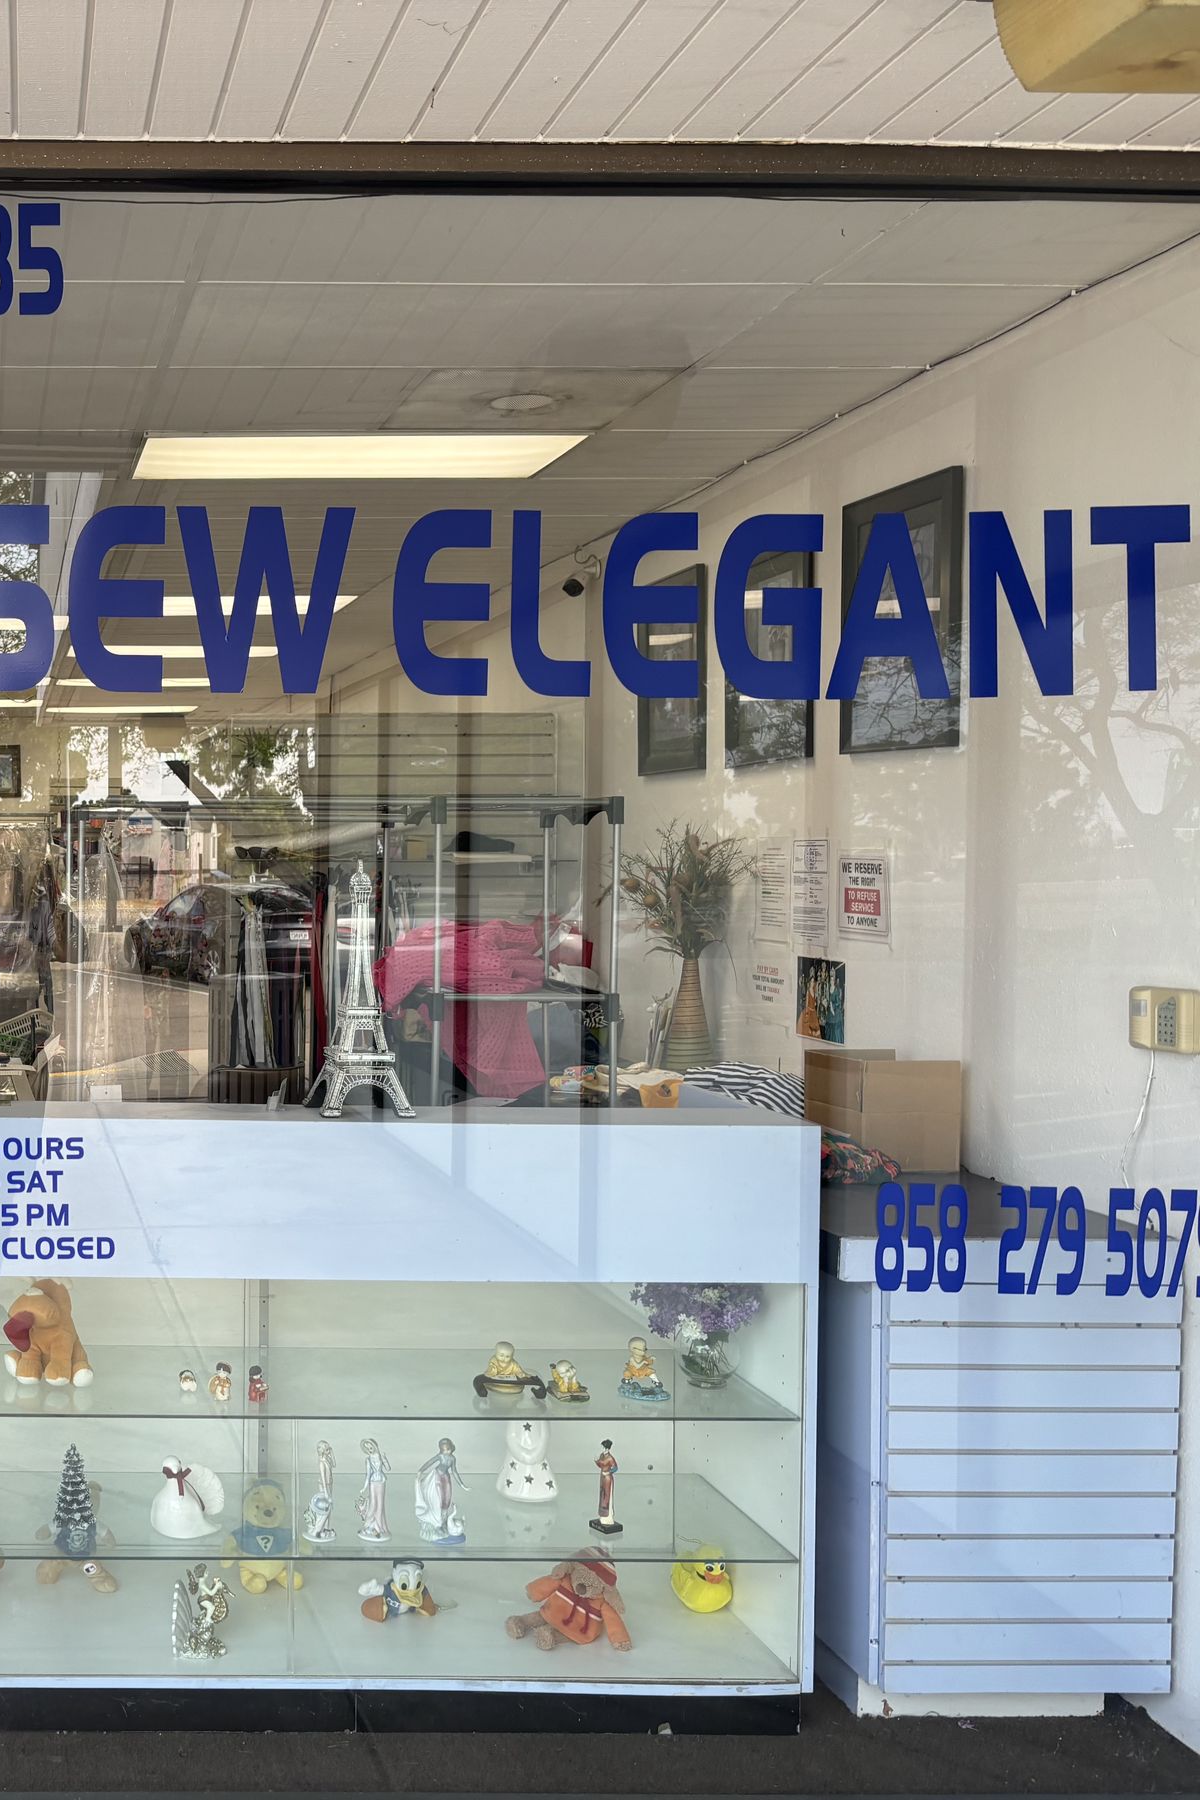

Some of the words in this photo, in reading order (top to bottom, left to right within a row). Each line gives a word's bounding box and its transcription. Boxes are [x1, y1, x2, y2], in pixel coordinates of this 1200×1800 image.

[392, 504, 1191, 701] ELEGANT
[842, 862, 852, 874] WE
[854, 863, 883, 875] RESERVE
[848, 876, 860, 886] THE
[861, 877, 876, 887] RIGHT
[847, 890, 856, 900] TO
[856, 891, 878, 902] REFUSE
[850, 901, 875, 913] SERVICE
[847, 915, 855, 925] TO
[855, 916, 878, 928] ANYONE
[6, 1170, 64, 1194] SAT
[874, 1182, 969, 1294] 858
[997, 1185, 1087, 1296] 279
[1104, 1186, 1200, 1299] 507
[1, 1236, 116, 1260] CLOSED
